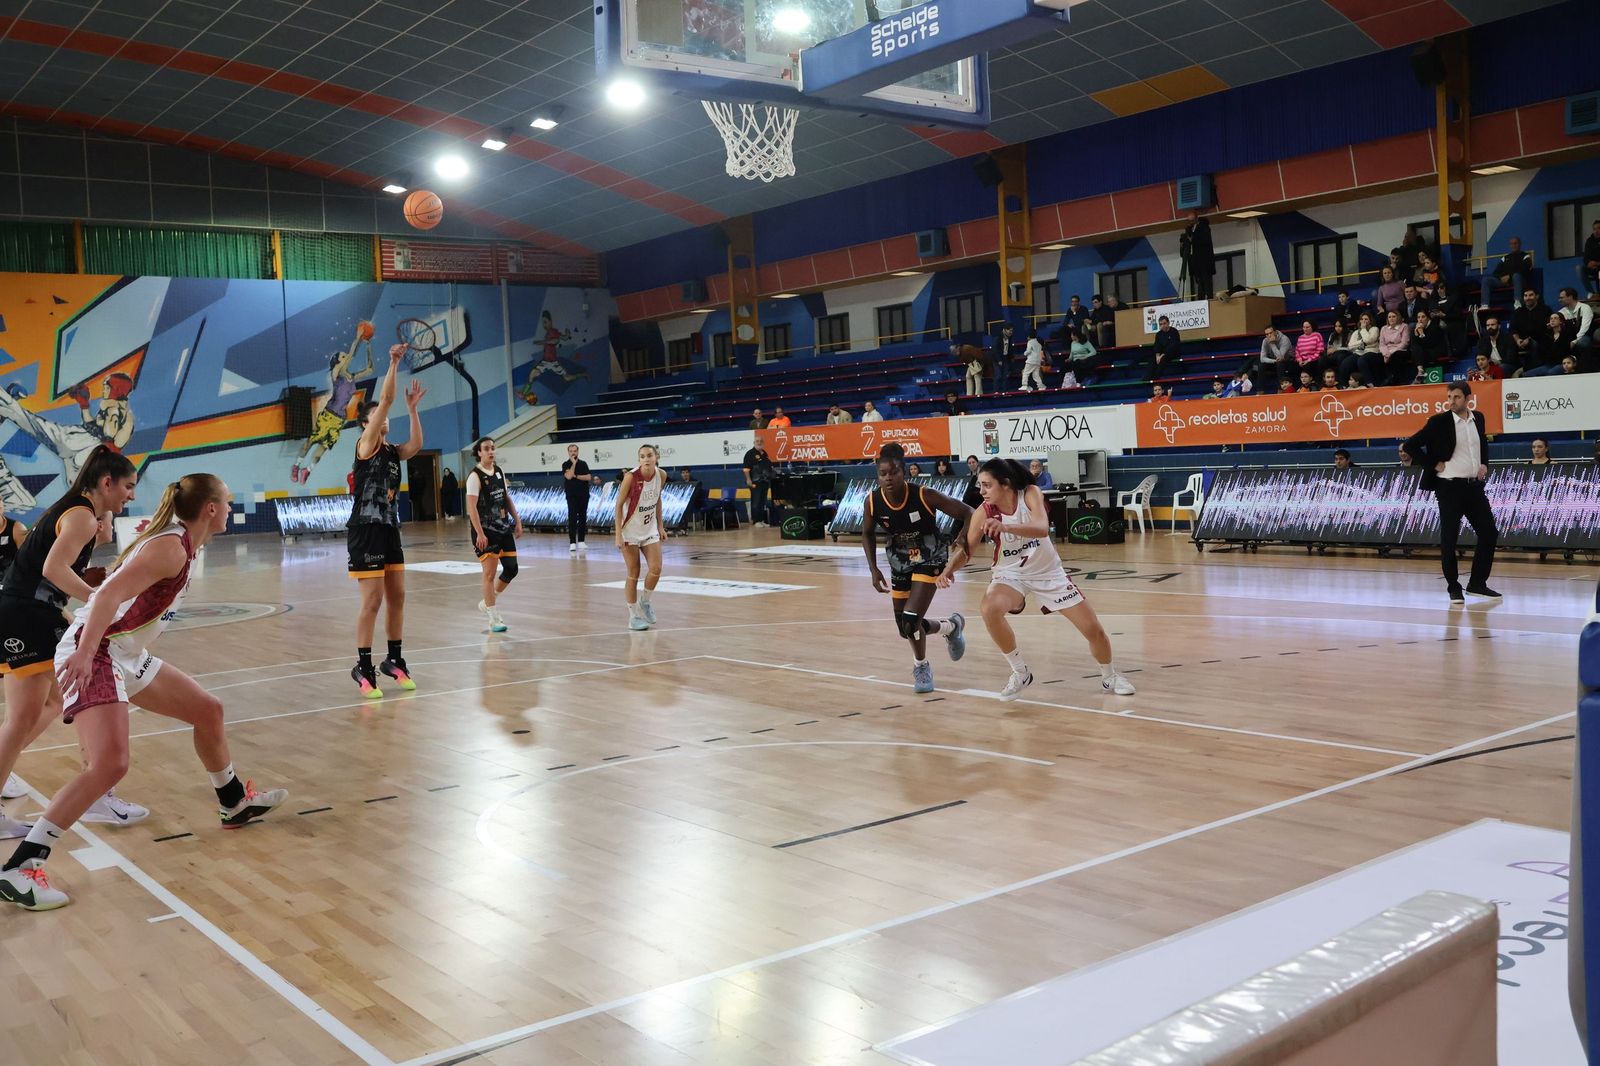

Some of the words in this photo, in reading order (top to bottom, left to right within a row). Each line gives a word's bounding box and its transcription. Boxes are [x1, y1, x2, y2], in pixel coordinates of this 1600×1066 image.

[871, 5, 939, 42] Schelde
[872, 21, 940, 57] Sports
[1356, 398, 1429, 418] recoletas
[1523, 397, 1574, 411] ZAMORA
[1188, 408, 1248, 426] recoletas
[1252, 406, 1287, 422] salud
[1008, 415, 1093, 442] ZAMORA
[1245, 425, 1287, 434] ZAMORA
[791, 447, 829, 460] ZAMORA
[1009, 445, 1061, 454] AYUNTAMIENTO
[1002, 538, 1041, 557] Bosonit
[1019, 555, 1029, 568] 7
[1062, 591, 1079, 602] RIOJA
[135, 668, 146, 680] LA
